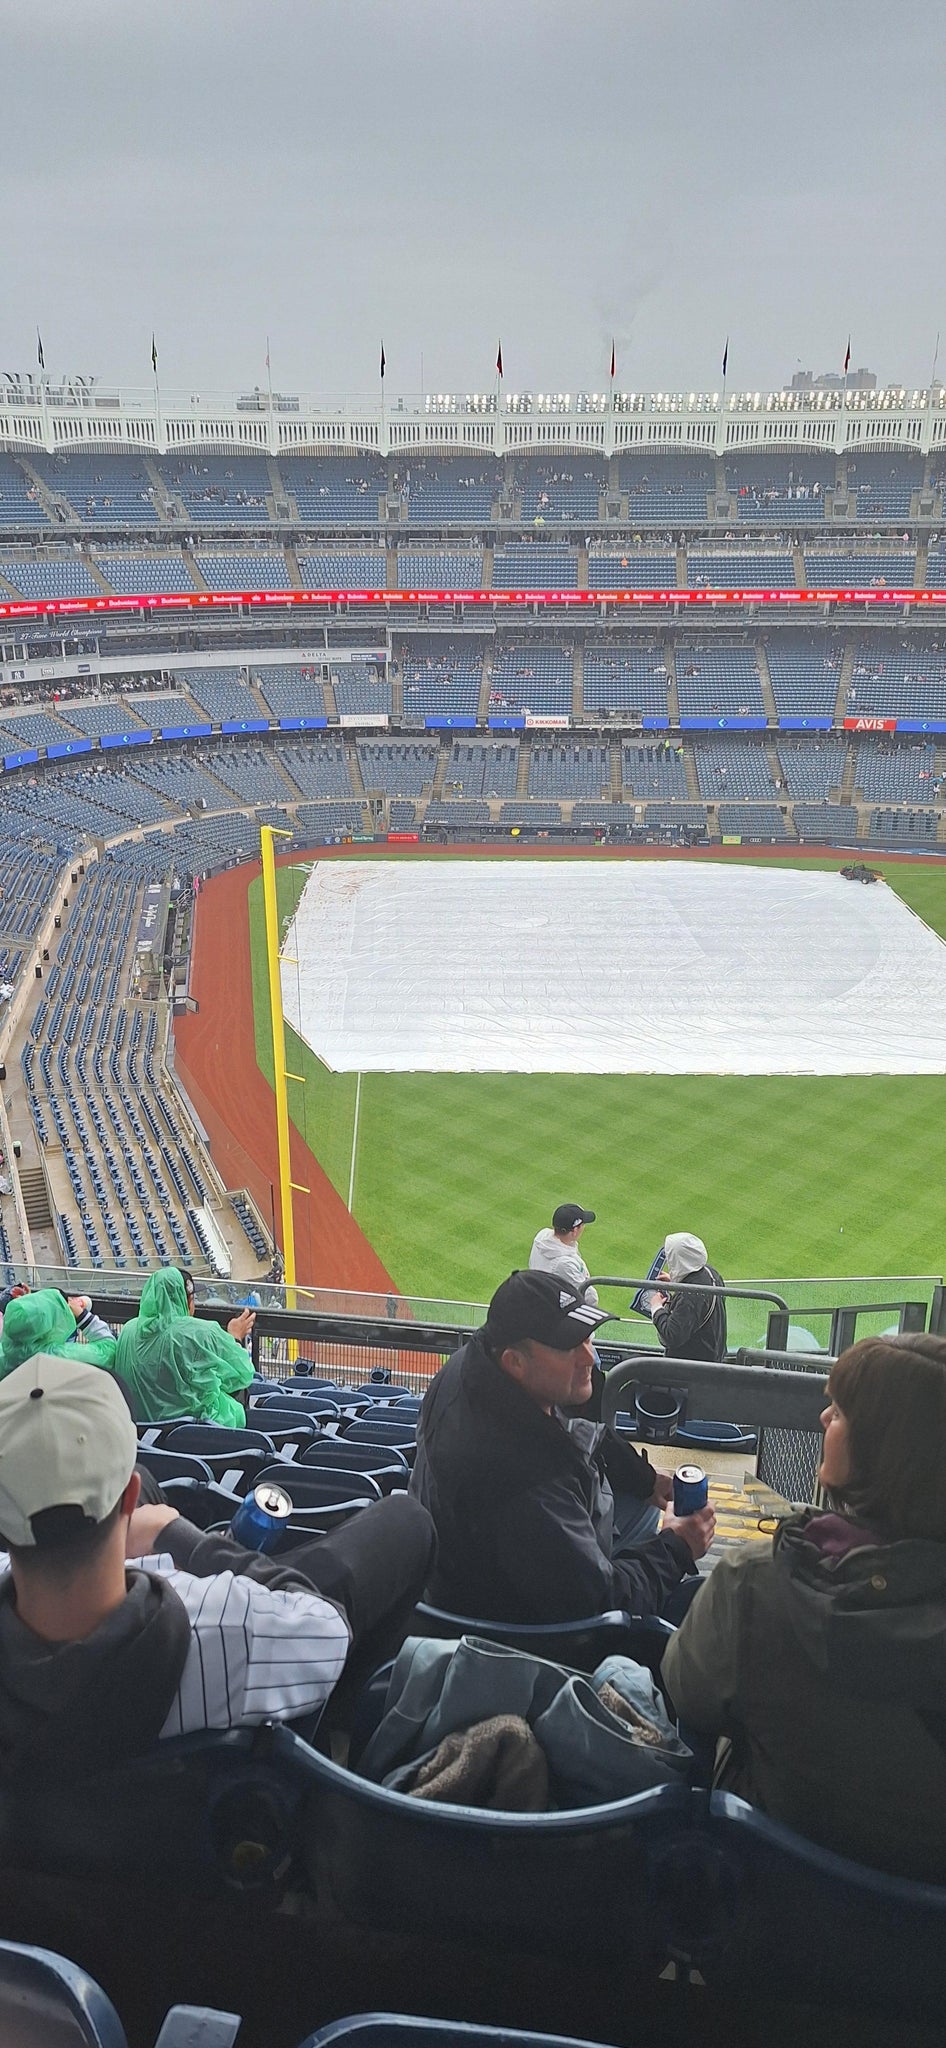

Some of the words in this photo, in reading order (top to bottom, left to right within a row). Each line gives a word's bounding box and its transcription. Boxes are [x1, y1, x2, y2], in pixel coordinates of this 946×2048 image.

[50, 629, 70, 637] World
[71, 628, 103, 637] Champions
[855, 719, 884, 729] AVIS
